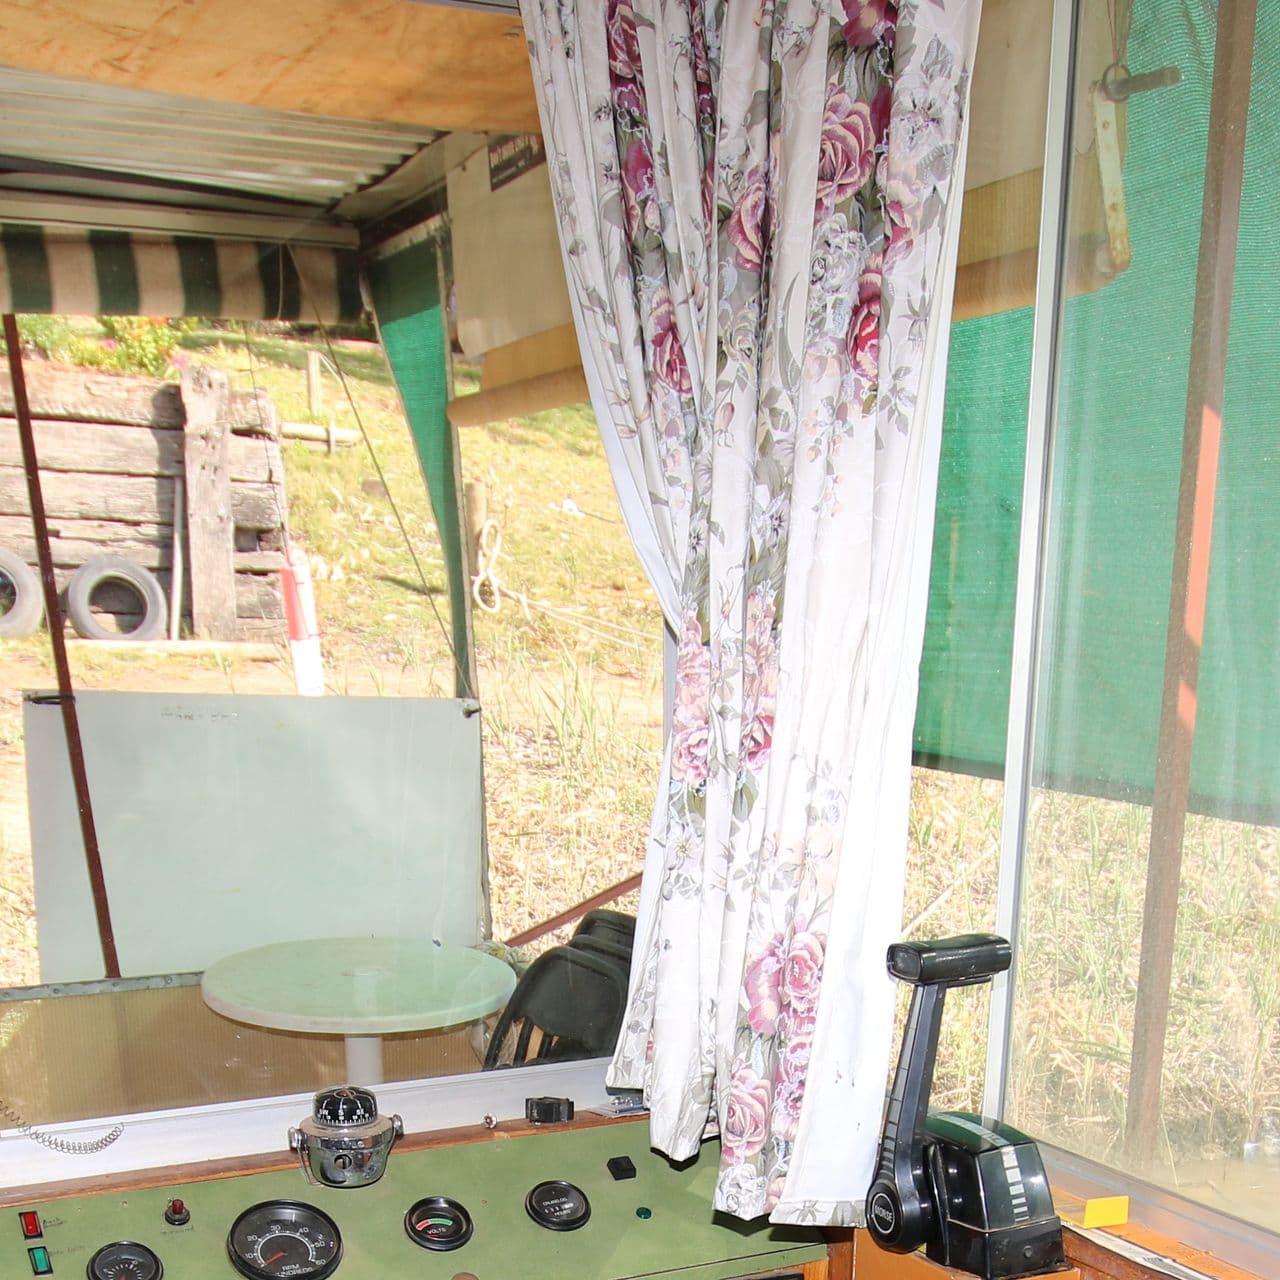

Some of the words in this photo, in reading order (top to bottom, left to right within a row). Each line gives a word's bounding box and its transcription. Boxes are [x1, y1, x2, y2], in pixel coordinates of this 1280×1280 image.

[270, 1224, 281, 1232] 30
[247, 1234, 258, 1242] 20
[315, 1258, 327, 1266] 60
